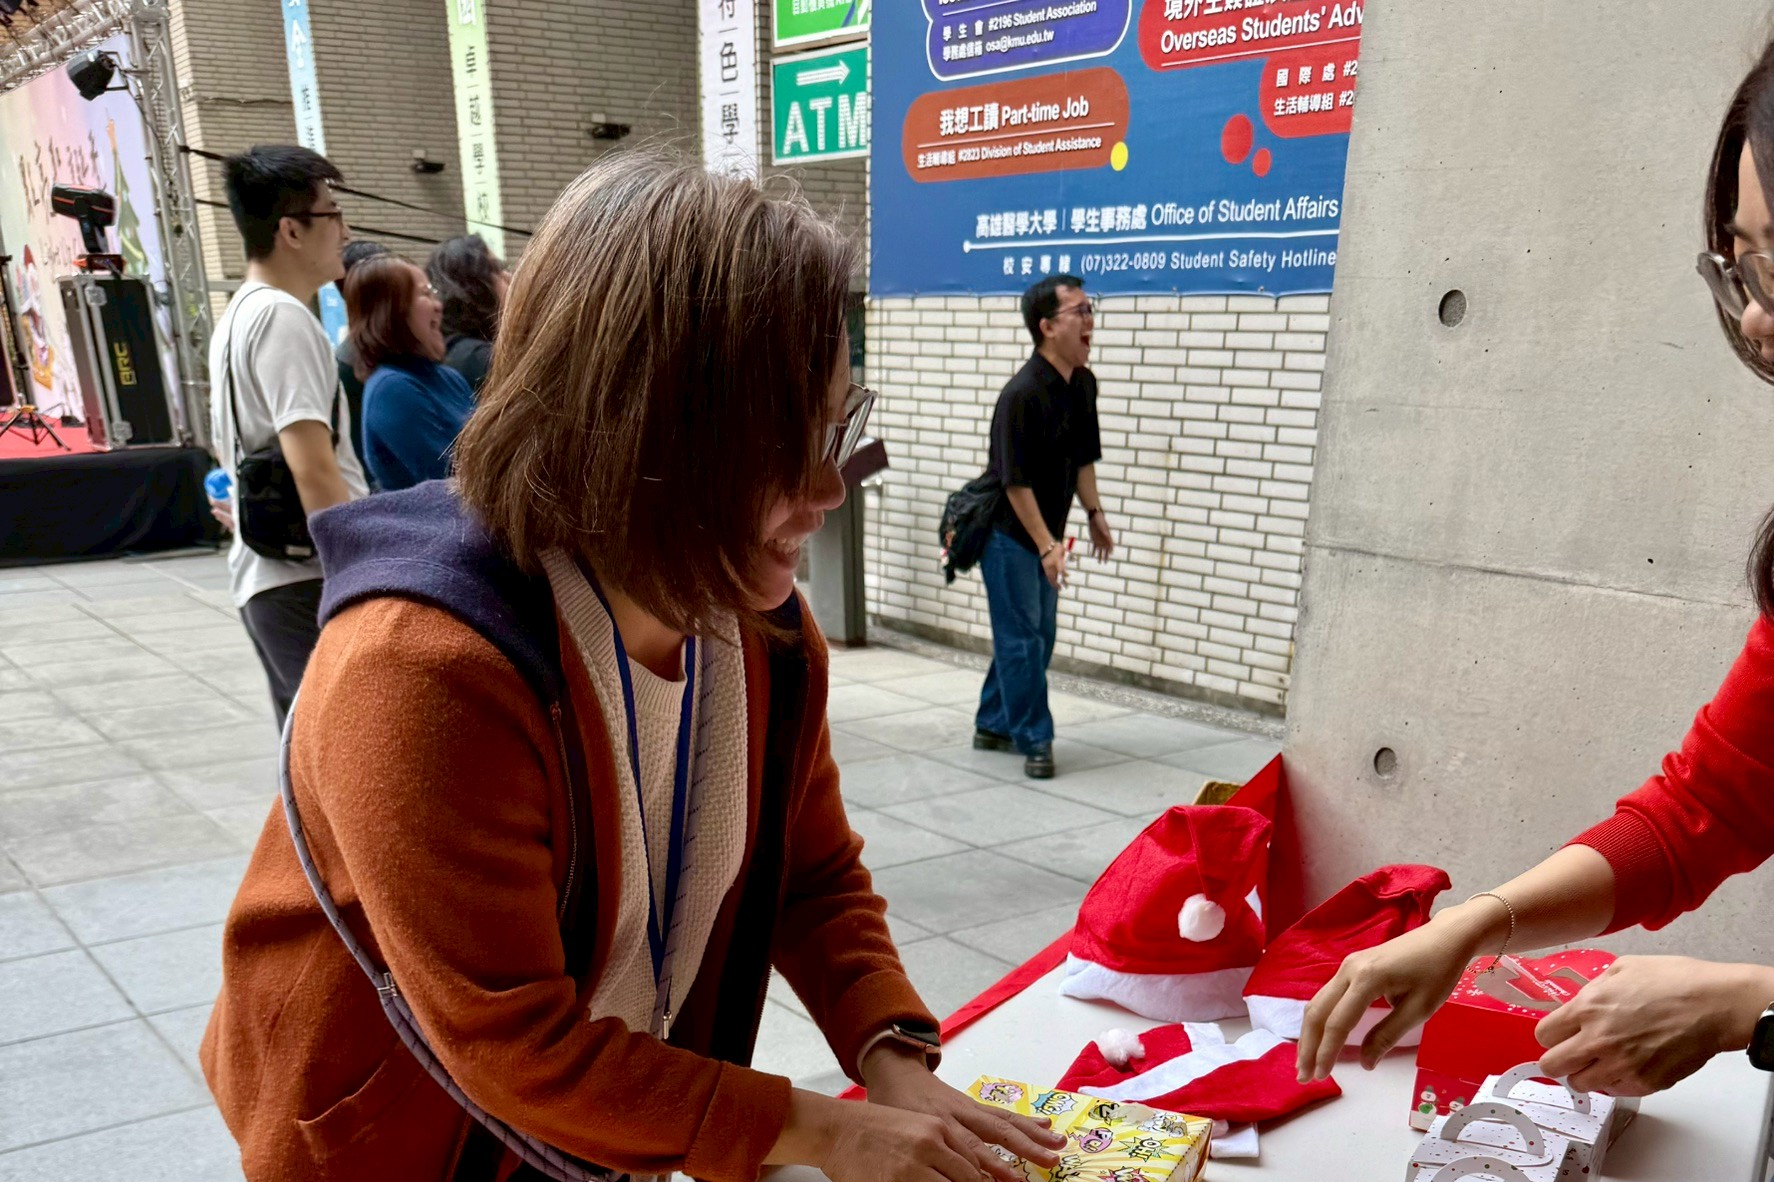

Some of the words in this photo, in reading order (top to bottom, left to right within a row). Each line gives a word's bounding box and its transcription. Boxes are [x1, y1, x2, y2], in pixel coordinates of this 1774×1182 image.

[1013, 10, 1045, 27] Student
[1046, 1, 1097, 19] Association
[1161, 24, 1237, 54] Overseas
[1241, 6, 1326, 41] Students'
[985, 29, 1055, 53] osa@kmu.edu.tw
[783, 91, 867, 155] ATM
[939, 102, 999, 136] 我想工讀
[1001, 101, 1060, 126] Part-time
[1062, 95, 1089, 119] Job
[981, 143, 1012, 160] Division
[1013, 142, 1022, 156] of
[1022, 139, 1054, 155] Student
[1055, 136, 1102, 151] Assistance
[976, 209, 1057, 238] 高雄醫學大學
[1070, 204, 1148, 233] 學生事務處
[1151, 202, 1194, 226] Office
[1198, 200, 1216, 224] of
[1217, 198, 1281, 222] Student
[1282, 195, 1339, 221] Affairs
[1080, 252, 1166, 275] (07)322-0809
[1170, 251, 1224, 269] Student
[1228, 249, 1277, 272] Safety
[1281, 248, 1337, 269] Hotline
